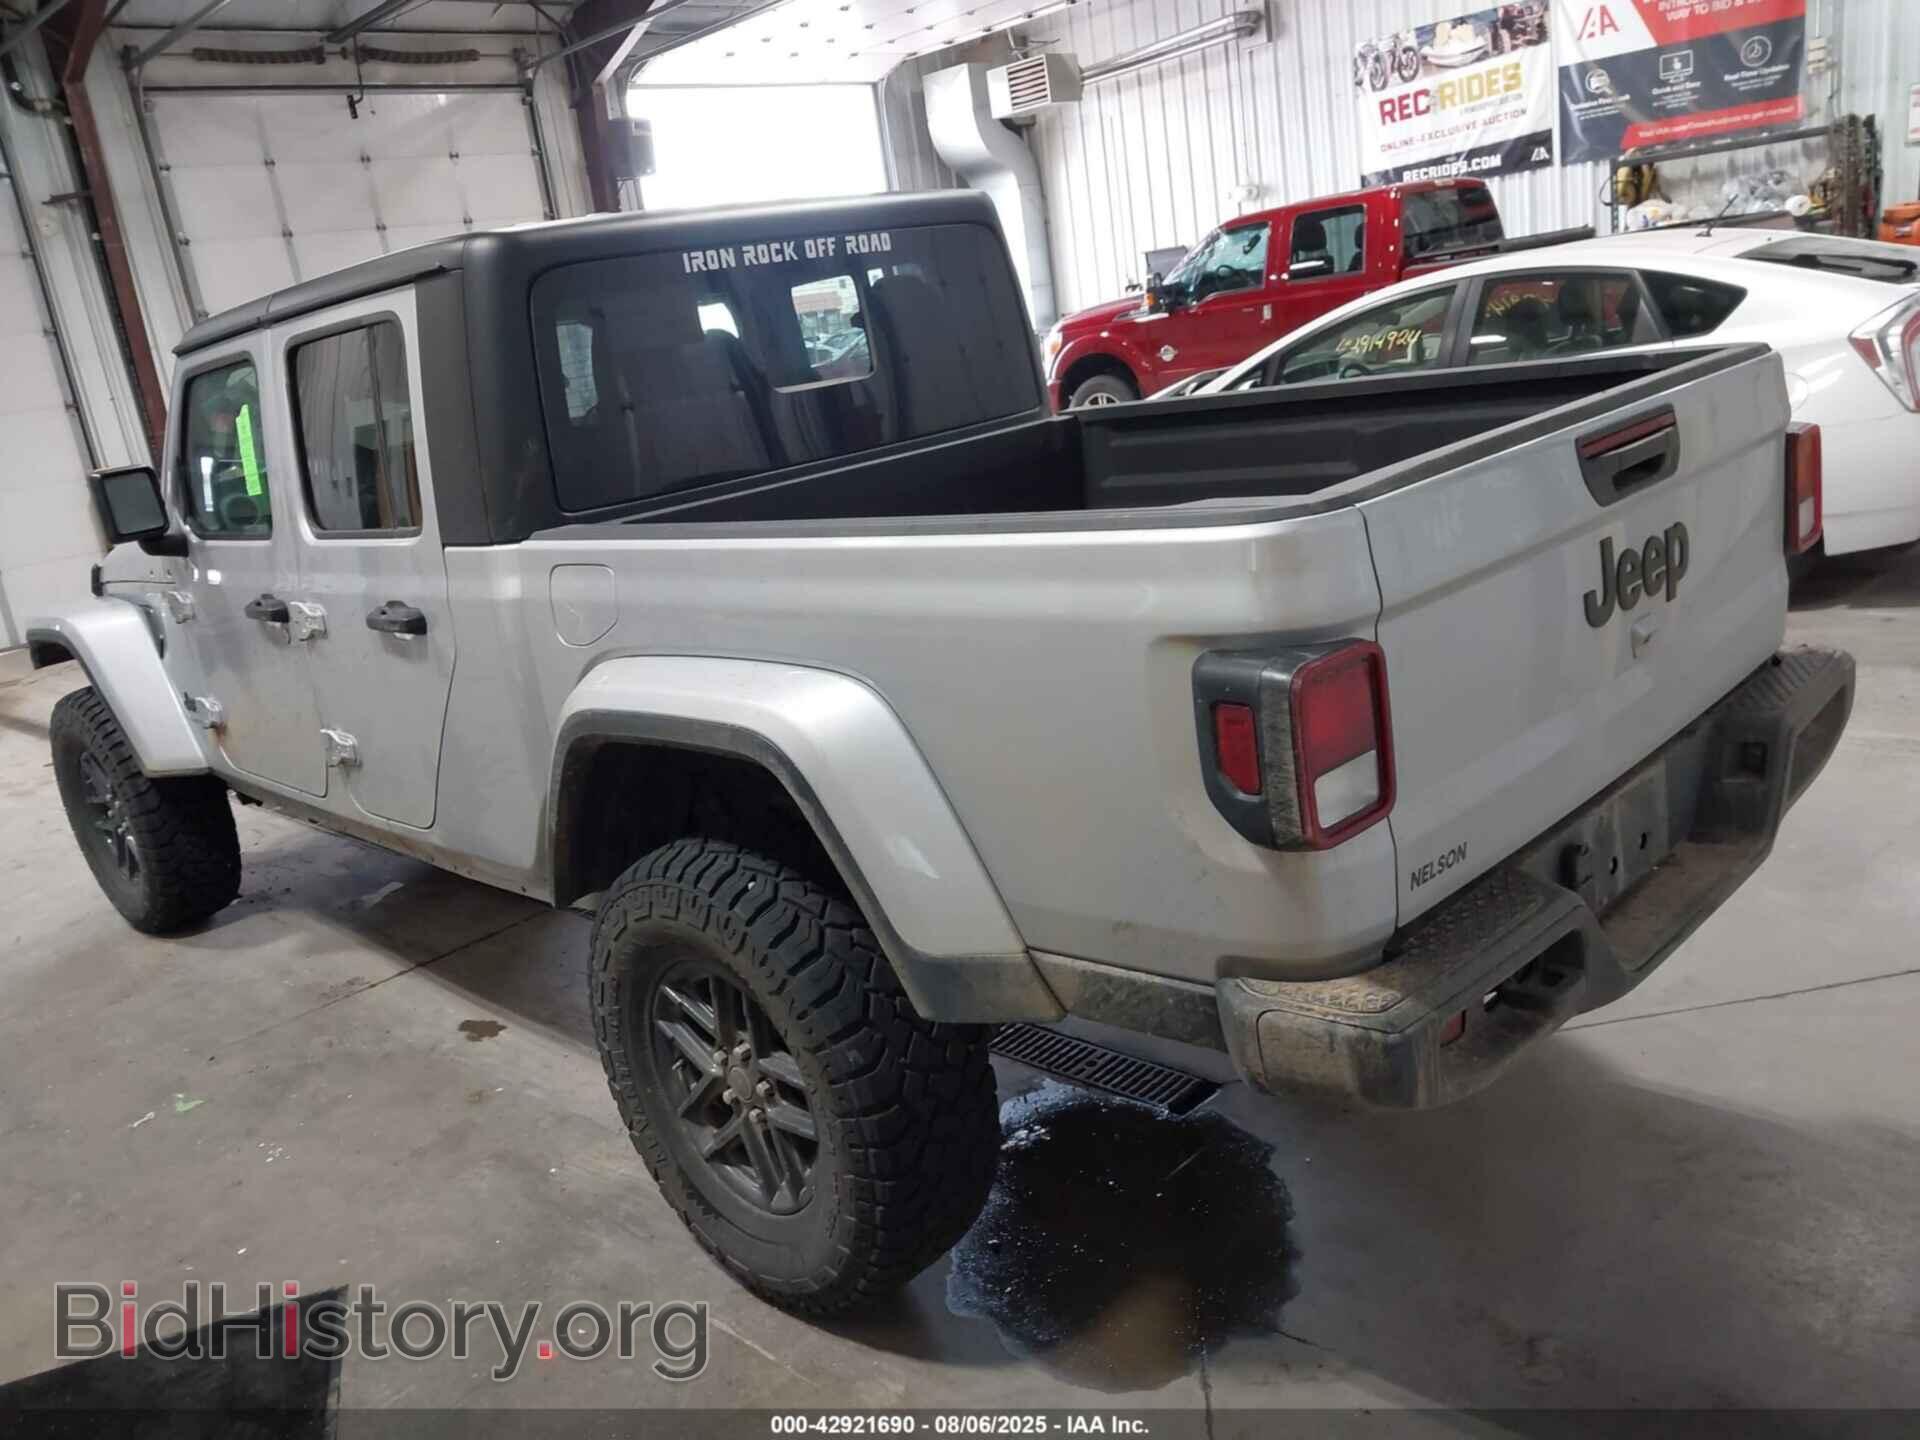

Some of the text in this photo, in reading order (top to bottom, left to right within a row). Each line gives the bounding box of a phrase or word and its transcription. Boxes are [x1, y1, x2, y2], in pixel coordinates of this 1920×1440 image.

[1379, 88, 1431, 126] REC
[1438, 62, 1522, 111] RIDES
[1482, 107, 1528, 128] AUCTION
[682, 232, 893, 273] IRON ROCK OFF ROAD
[1583, 521, 1690, 628] Jeep
[1410, 840, 1468, 892] NELSON
